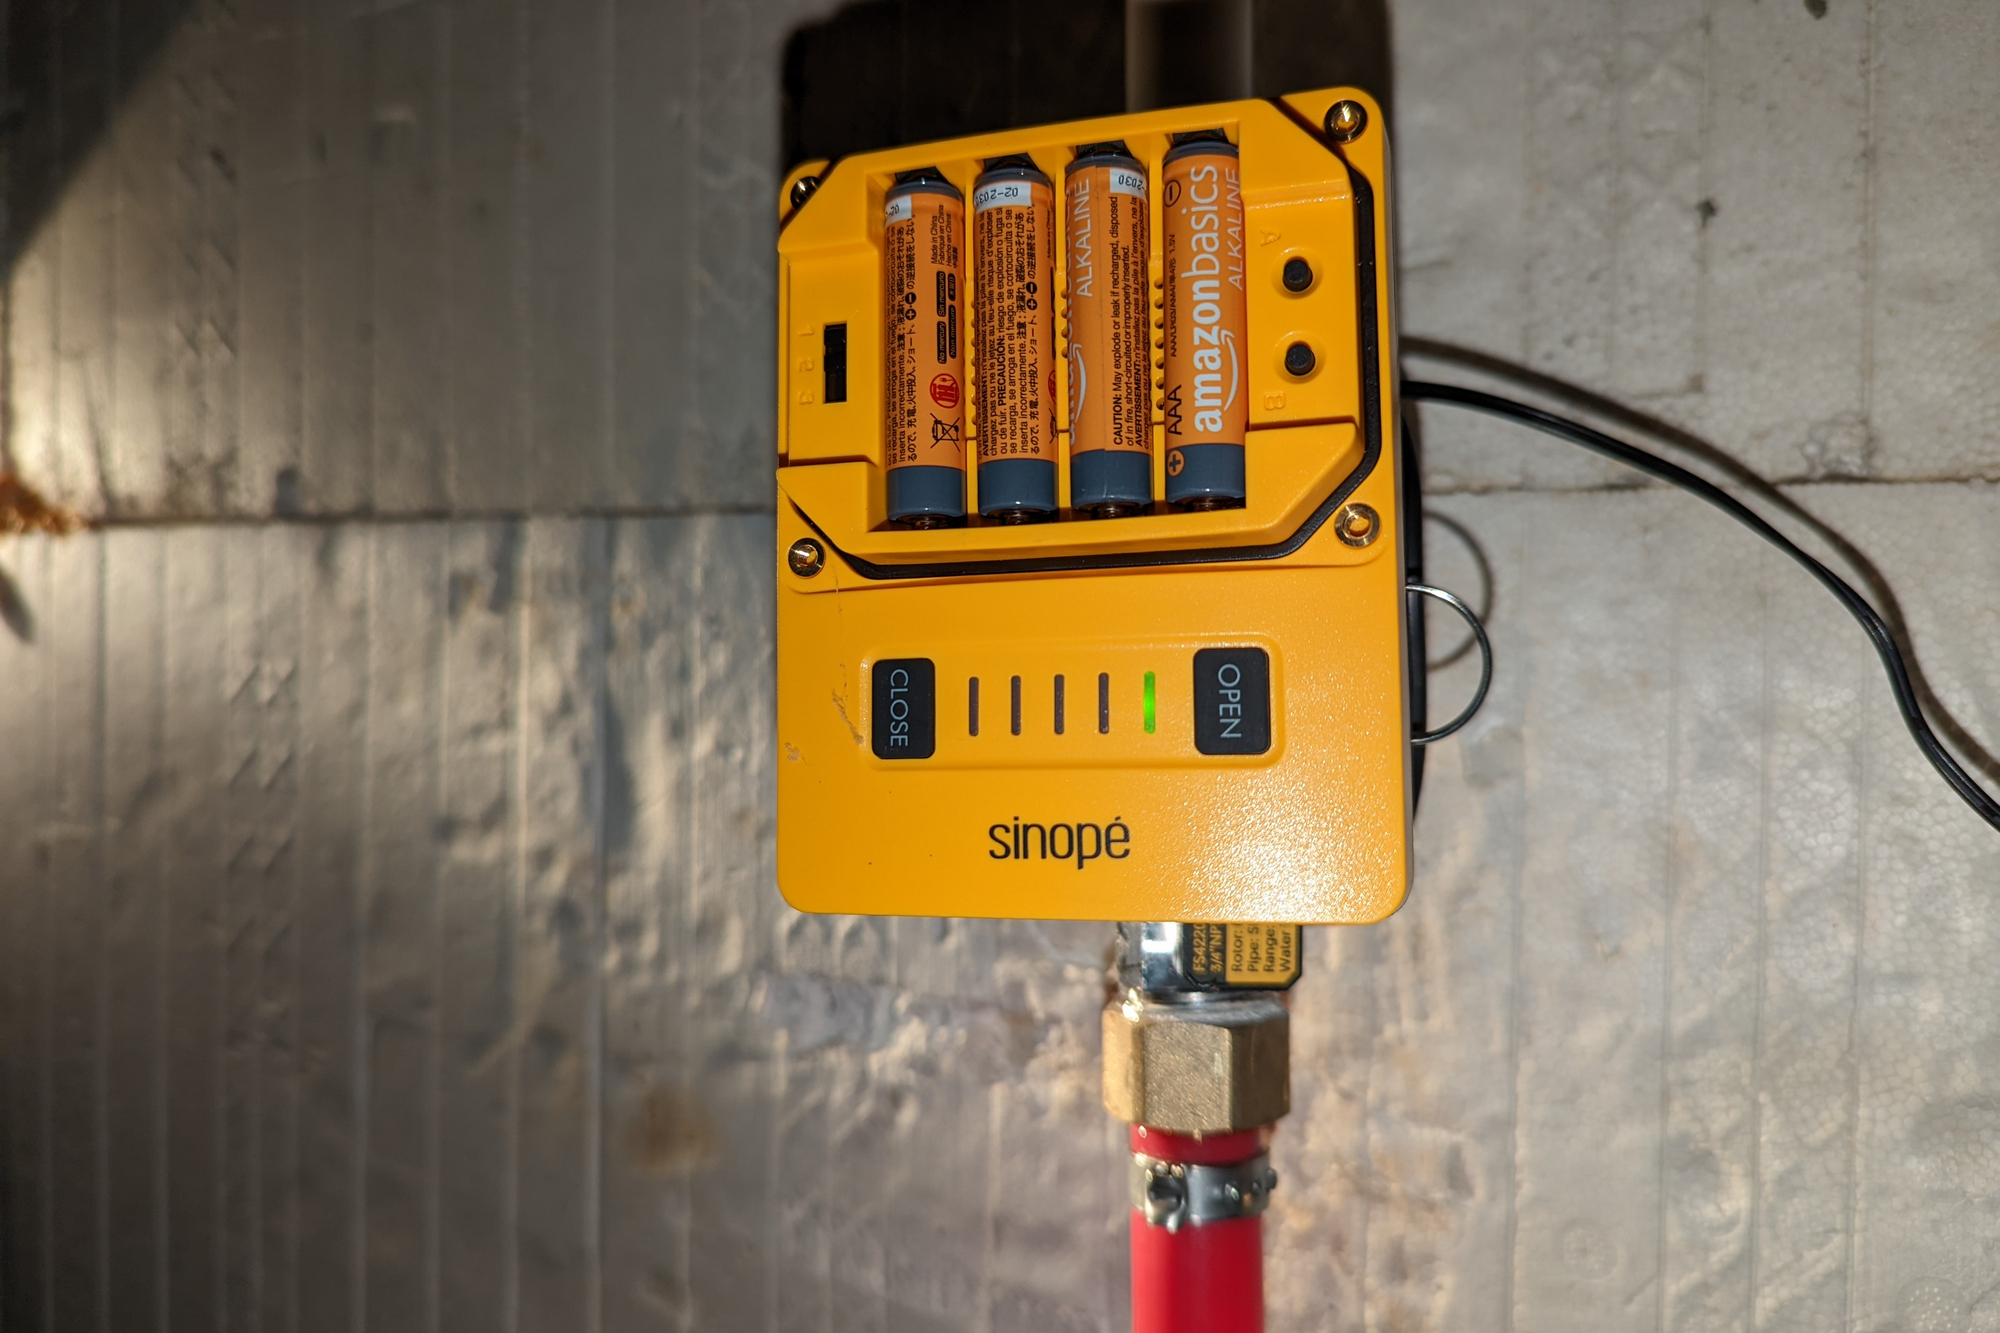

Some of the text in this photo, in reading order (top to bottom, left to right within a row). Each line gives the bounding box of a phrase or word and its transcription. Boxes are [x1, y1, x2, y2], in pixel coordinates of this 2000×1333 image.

[1130, 197, 1137, 205] la
[1006, 210, 1012, 220] se
[1109, 197, 1119, 238] disposed
[1132, 207, 1137, 219] ne
[891, 227, 895, 237] se
[939, 226, 944, 234] en
[995, 218, 1004, 238] fuga
[1074, 179, 1092, 297] ALKALINE
[1225, 168, 1243, 289] ALKALINE
[948, 235, 951, 243] en
[1131, 222, 1139, 258] l'envers,
[995, 247, 1005, 290] explosión
[1005, 231, 1013, 286] cortocircuita
[1110, 241, 1120, 288] recharged,
[996, 292, 1004, 303] de
[1007, 289, 1013, 299] se
[1181, 166, 1222, 432] amazonbasics
[891, 303, 895, 313] se
[1110, 298, 1120, 318] leak
[1123, 283, 1131, 329] improperly
[997, 306, 1006, 333] riesgo
[1007, 302, 1016, 331] fuego,
[1111, 320, 1120, 329] or
[989, 325, 995, 336] au
[1007, 333, 1014, 341] el
[1124, 330, 1131, 339] or
[891, 346, 896, 355] el
[939, 352, 945, 363] No
[988, 340, 997, 361] jetez
[1009, 344, 1015, 355] en
[1111, 332, 1122, 369] explode
[891, 357, 896, 367] en
[989, 363, 995, 371] le
[996, 335, 1006, 406] PRECAUCIÓN:
[1009, 357, 1017, 387] arroga
[990, 372, 996, 384] ne
[1018, 341, 1027, 418] incorrectamente.
[1113, 372, 1122, 391] May
[1123, 341, 1133, 404] short-circuited
[990, 386, 996, 398] ou
[1010, 389, 1016, 400] se
[892, 401, 897, 412] se
[1134, 359, 1142, 447] AVERTISSEMENT:
[1167, 385, 1182, 435] AAA
[1009, 403, 1018, 440] recarga,
[1113, 394, 1122, 445] CAUTION:
[1125, 406, 1134, 423] fire,
[989, 419, 998, 456] chargez
[1000, 427, 1007, 439] de
[1020, 422, 1028, 453] inserta
[1125, 426, 1133, 434] in
[1000, 442, 1007, 454] ou
[1010, 443, 1017, 454] se
[1125, 437, 1133, 446] of
[892, 453, 897, 464] se
[890, 668, 909, 747] CLOSE
[1218, 663, 1242, 738] OPEN
[989, 816, 1130, 870] sinopé
[1232, 930, 1243, 972] Rotor:
[1247, 939, 1261, 972] Pipe:
[1263, 925, 1276, 972] Range:
[1279, 931, 1291, 972] Water
